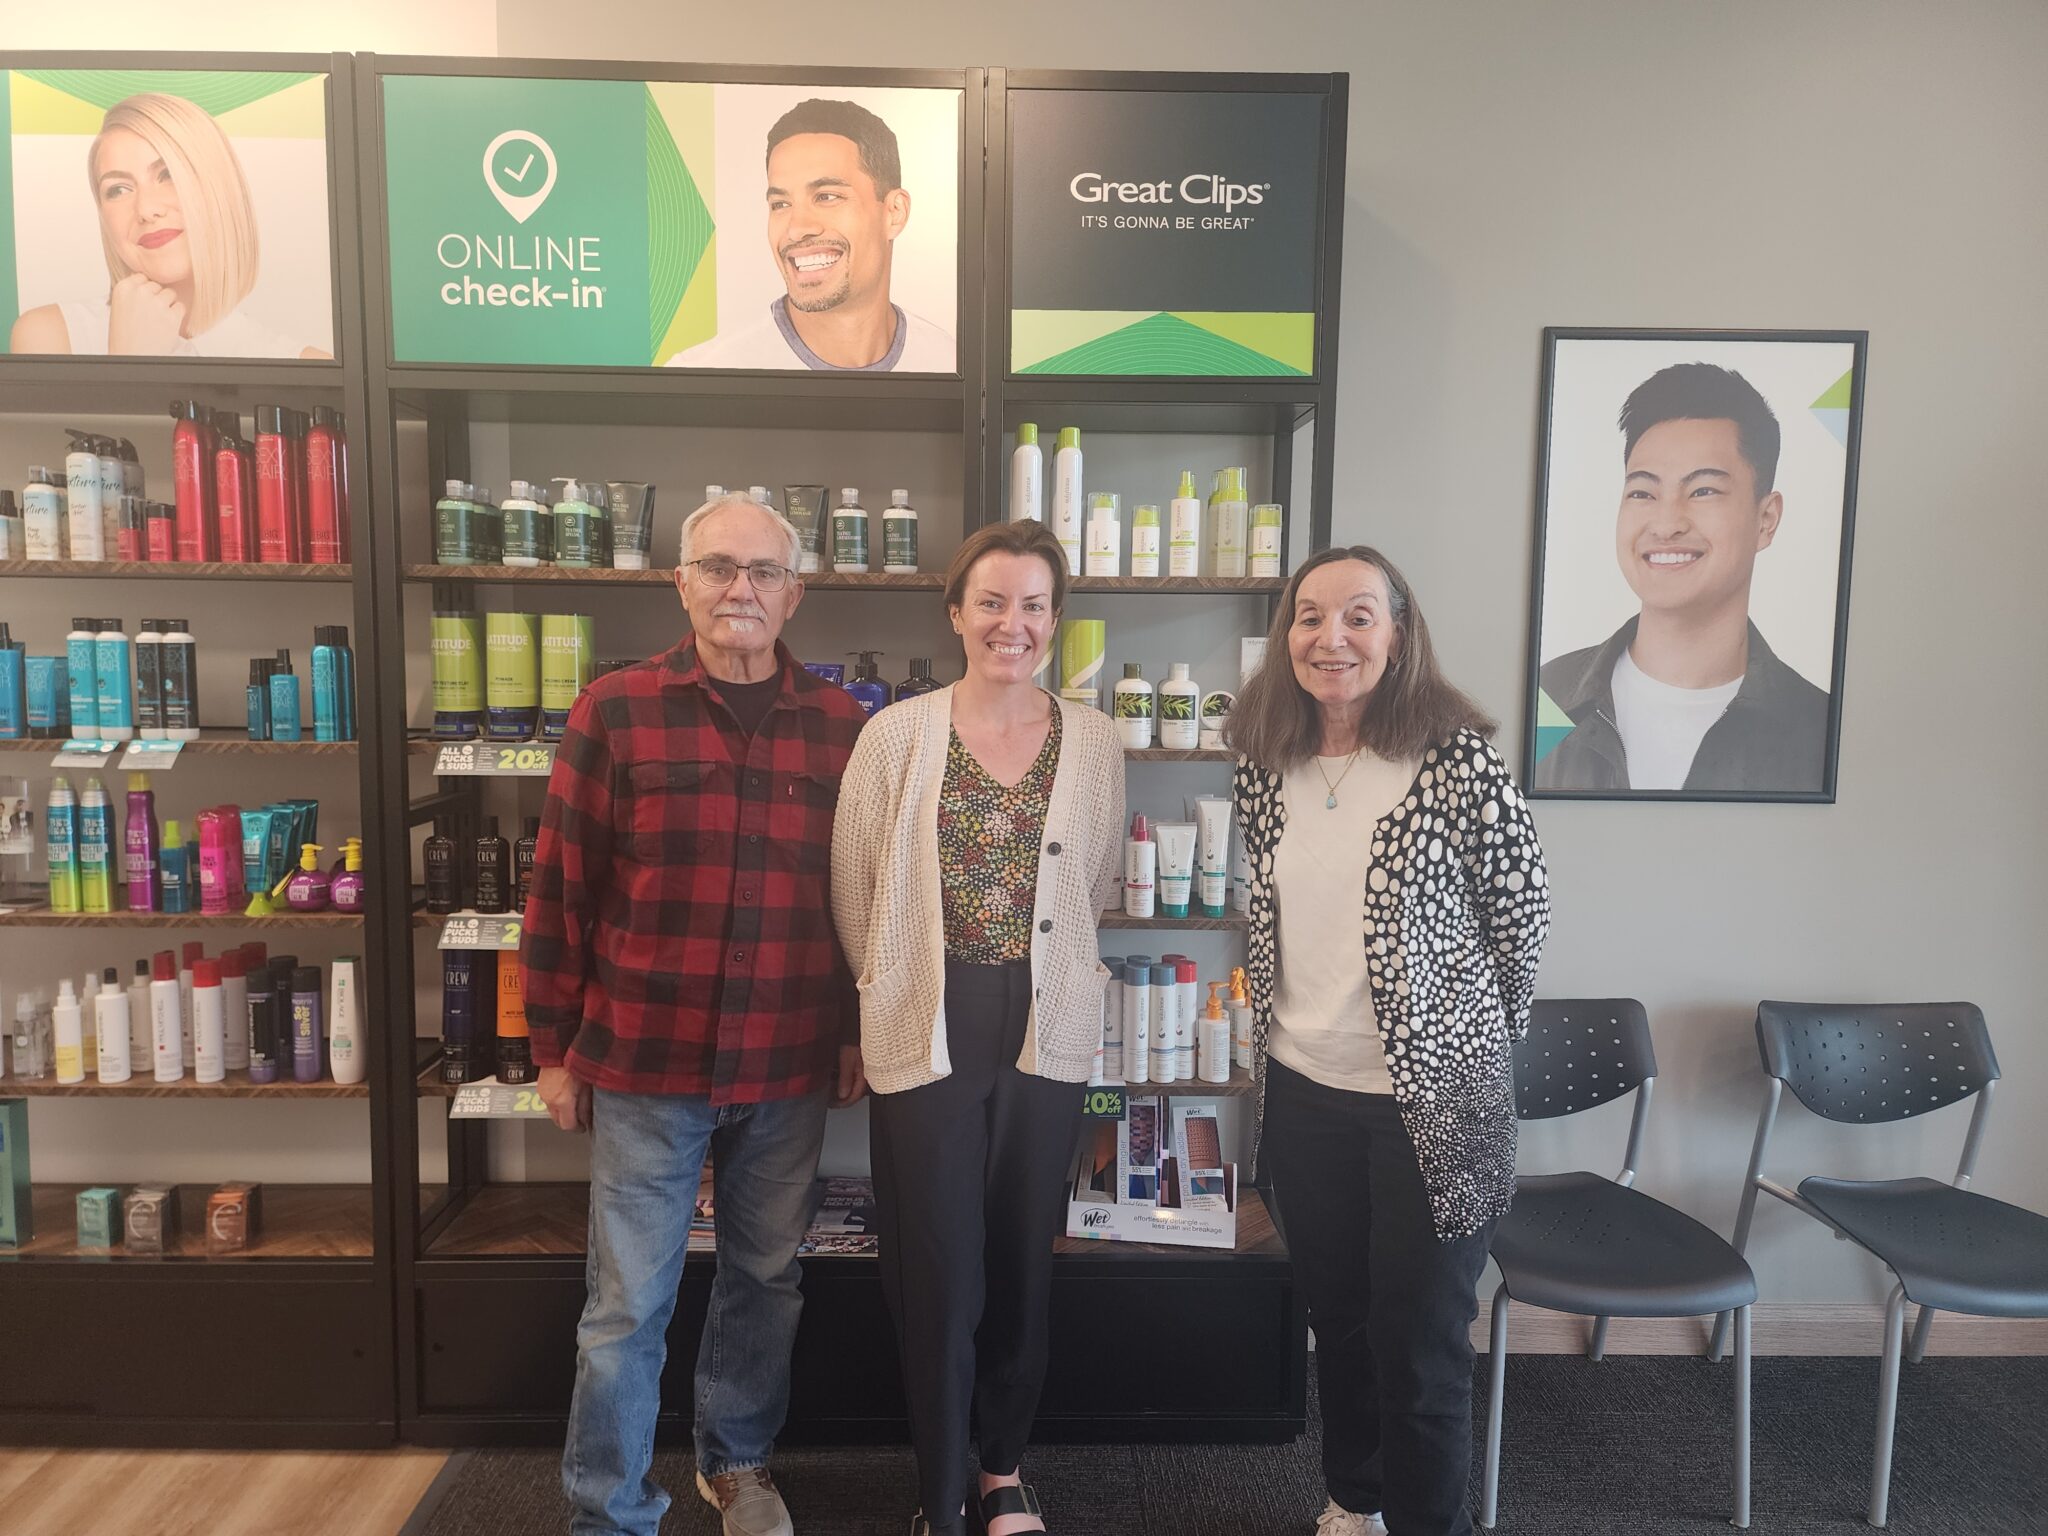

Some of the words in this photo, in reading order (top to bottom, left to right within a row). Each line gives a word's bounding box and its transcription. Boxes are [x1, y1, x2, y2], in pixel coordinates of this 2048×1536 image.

[1070, 172, 1173, 203] Great
[1081, 215, 1108, 228] IT'S
[1113, 216, 1170, 229] GONNA
[1175, 217, 1195, 229] BE
[437, 233, 601, 271] ONLINE
[441, 275, 603, 308] check-in
[431, 639, 471, 650] ATITUDE
[487, 634, 528, 646] ATITUDE
[543, 636, 583, 648] ATITUDE
[439, 755, 474, 763] PUCKS
[429, 850, 449, 861] CREW
[477, 851, 497, 862] CREW
[446, 920, 466, 928] ALL
[445, 928, 478, 936] PUCKS
[442, 936, 450, 944] &
[451, 936, 478, 944] SUDS
[446, 971, 469, 985] CREW
[503, 974, 519, 989] CRE
[293, 1006, 302, 1020] So
[300, 1005, 311, 1036] Silver
[447, 1069, 464, 1079] CREW
[507, 1069, 525, 1079] CREW
[1107, 1106, 1122, 1114] off
[1186, 1108, 1201, 1116] Wet
[1119, 1140, 1128, 1182] detangler
[1083, 1211, 1108, 1227] Wet
[1134, 1215, 1168, 1225] effortlessly
[1169, 1217, 1198, 1227] detangle
[1166, 1224, 1181, 1232] pain
[1191, 1226, 1223, 1234] breakage
